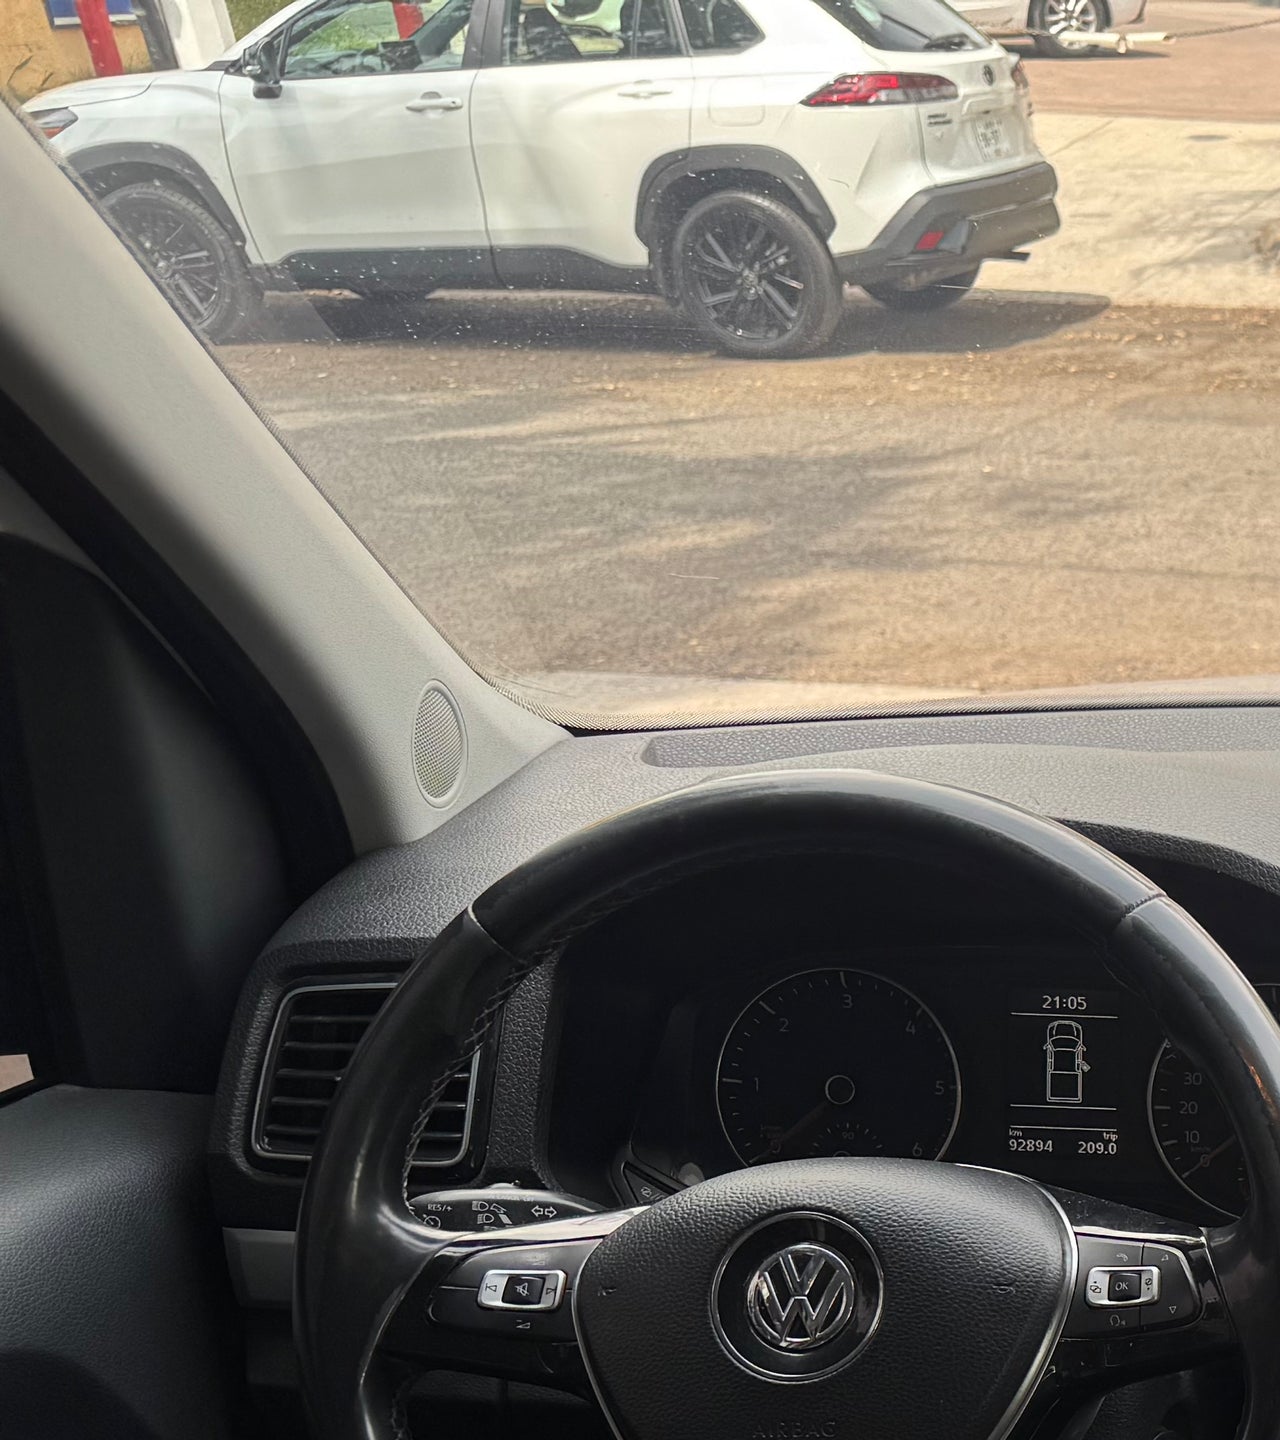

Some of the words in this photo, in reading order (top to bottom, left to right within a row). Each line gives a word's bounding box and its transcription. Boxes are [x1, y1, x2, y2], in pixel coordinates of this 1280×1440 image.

[842, 993, 854, 1008] 3
[1041, 995, 1087, 1010] 21:05
[779, 1018, 790, 1032] 2
[904, 1020, 916, 1035] 4
[753, 1077, 760, 1092] 1
[1183, 1071, 1202, 1085] 30
[934, 1081, 945, 1096] 5
[1179, 1101, 1199, 1115] 20
[1008, 1128, 1022, 1137] km
[1103, 1131, 1118, 1142] trip
[1184, 1130, 1200, 1144] 10
[912, 1142, 923, 1157] 6
[1008, 1139, 1054, 1153] 92894
[1077, 1141, 1118, 1155] 209.0
[1115, 1281, 1129, 1291] OK
[752, 1421, 836, 1438] AIRBAG
